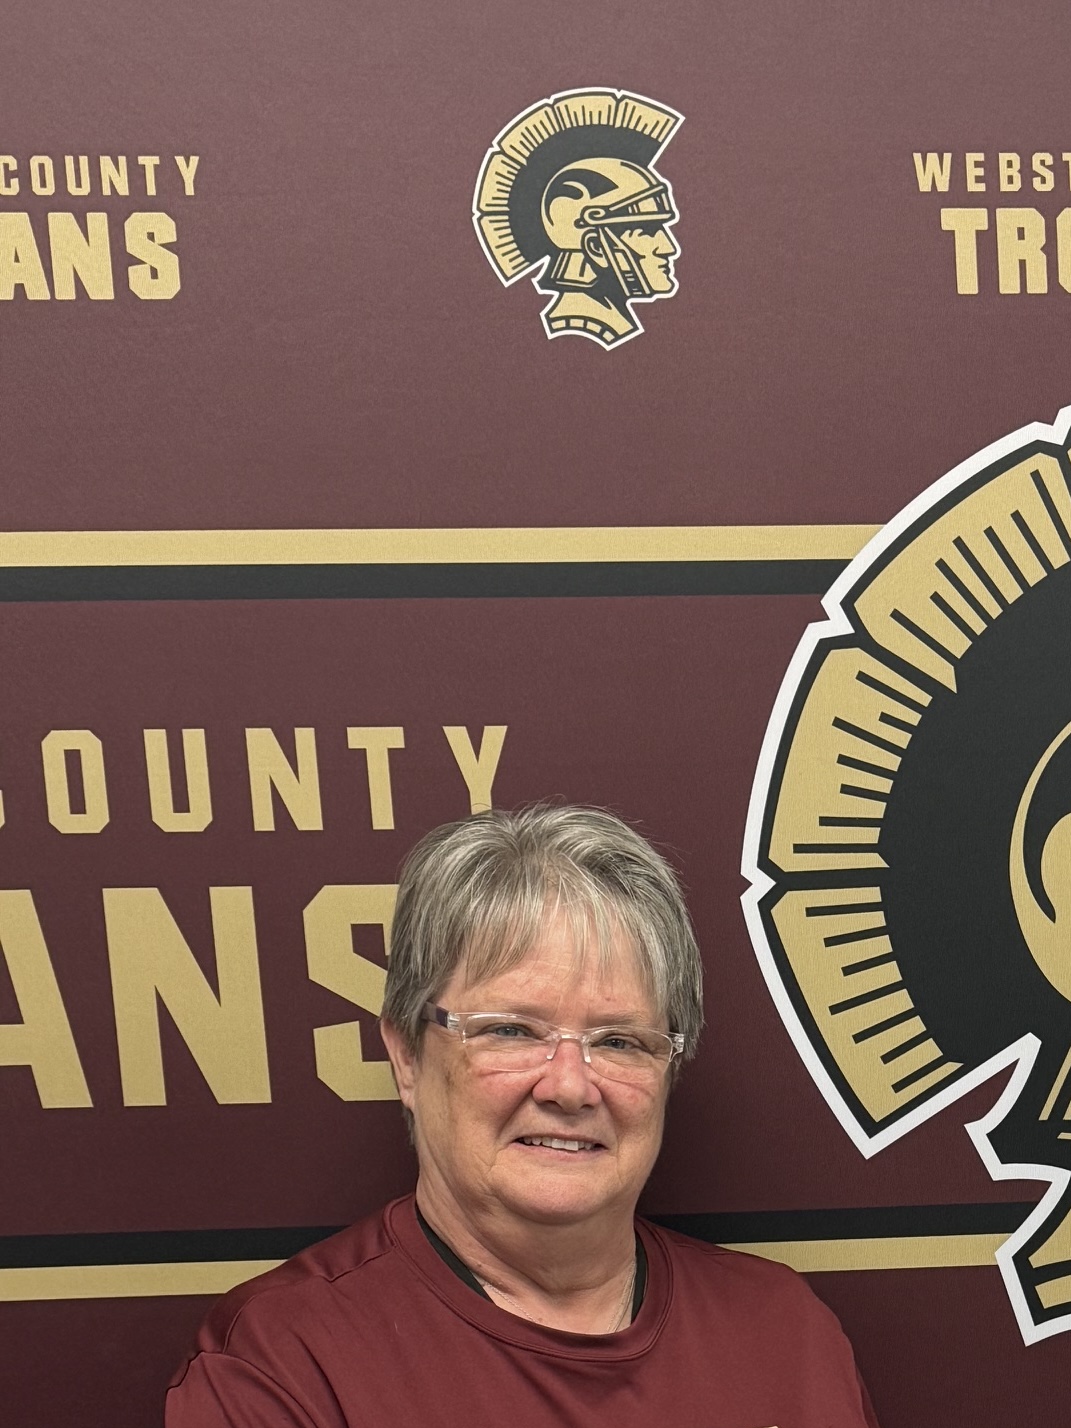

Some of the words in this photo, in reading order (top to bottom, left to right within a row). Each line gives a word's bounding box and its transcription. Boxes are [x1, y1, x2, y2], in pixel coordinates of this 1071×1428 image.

[0, 154, 200, 196] COUNTY
[0, 212, 182, 301] ANS
[0, 725, 508, 834] OUNTY
